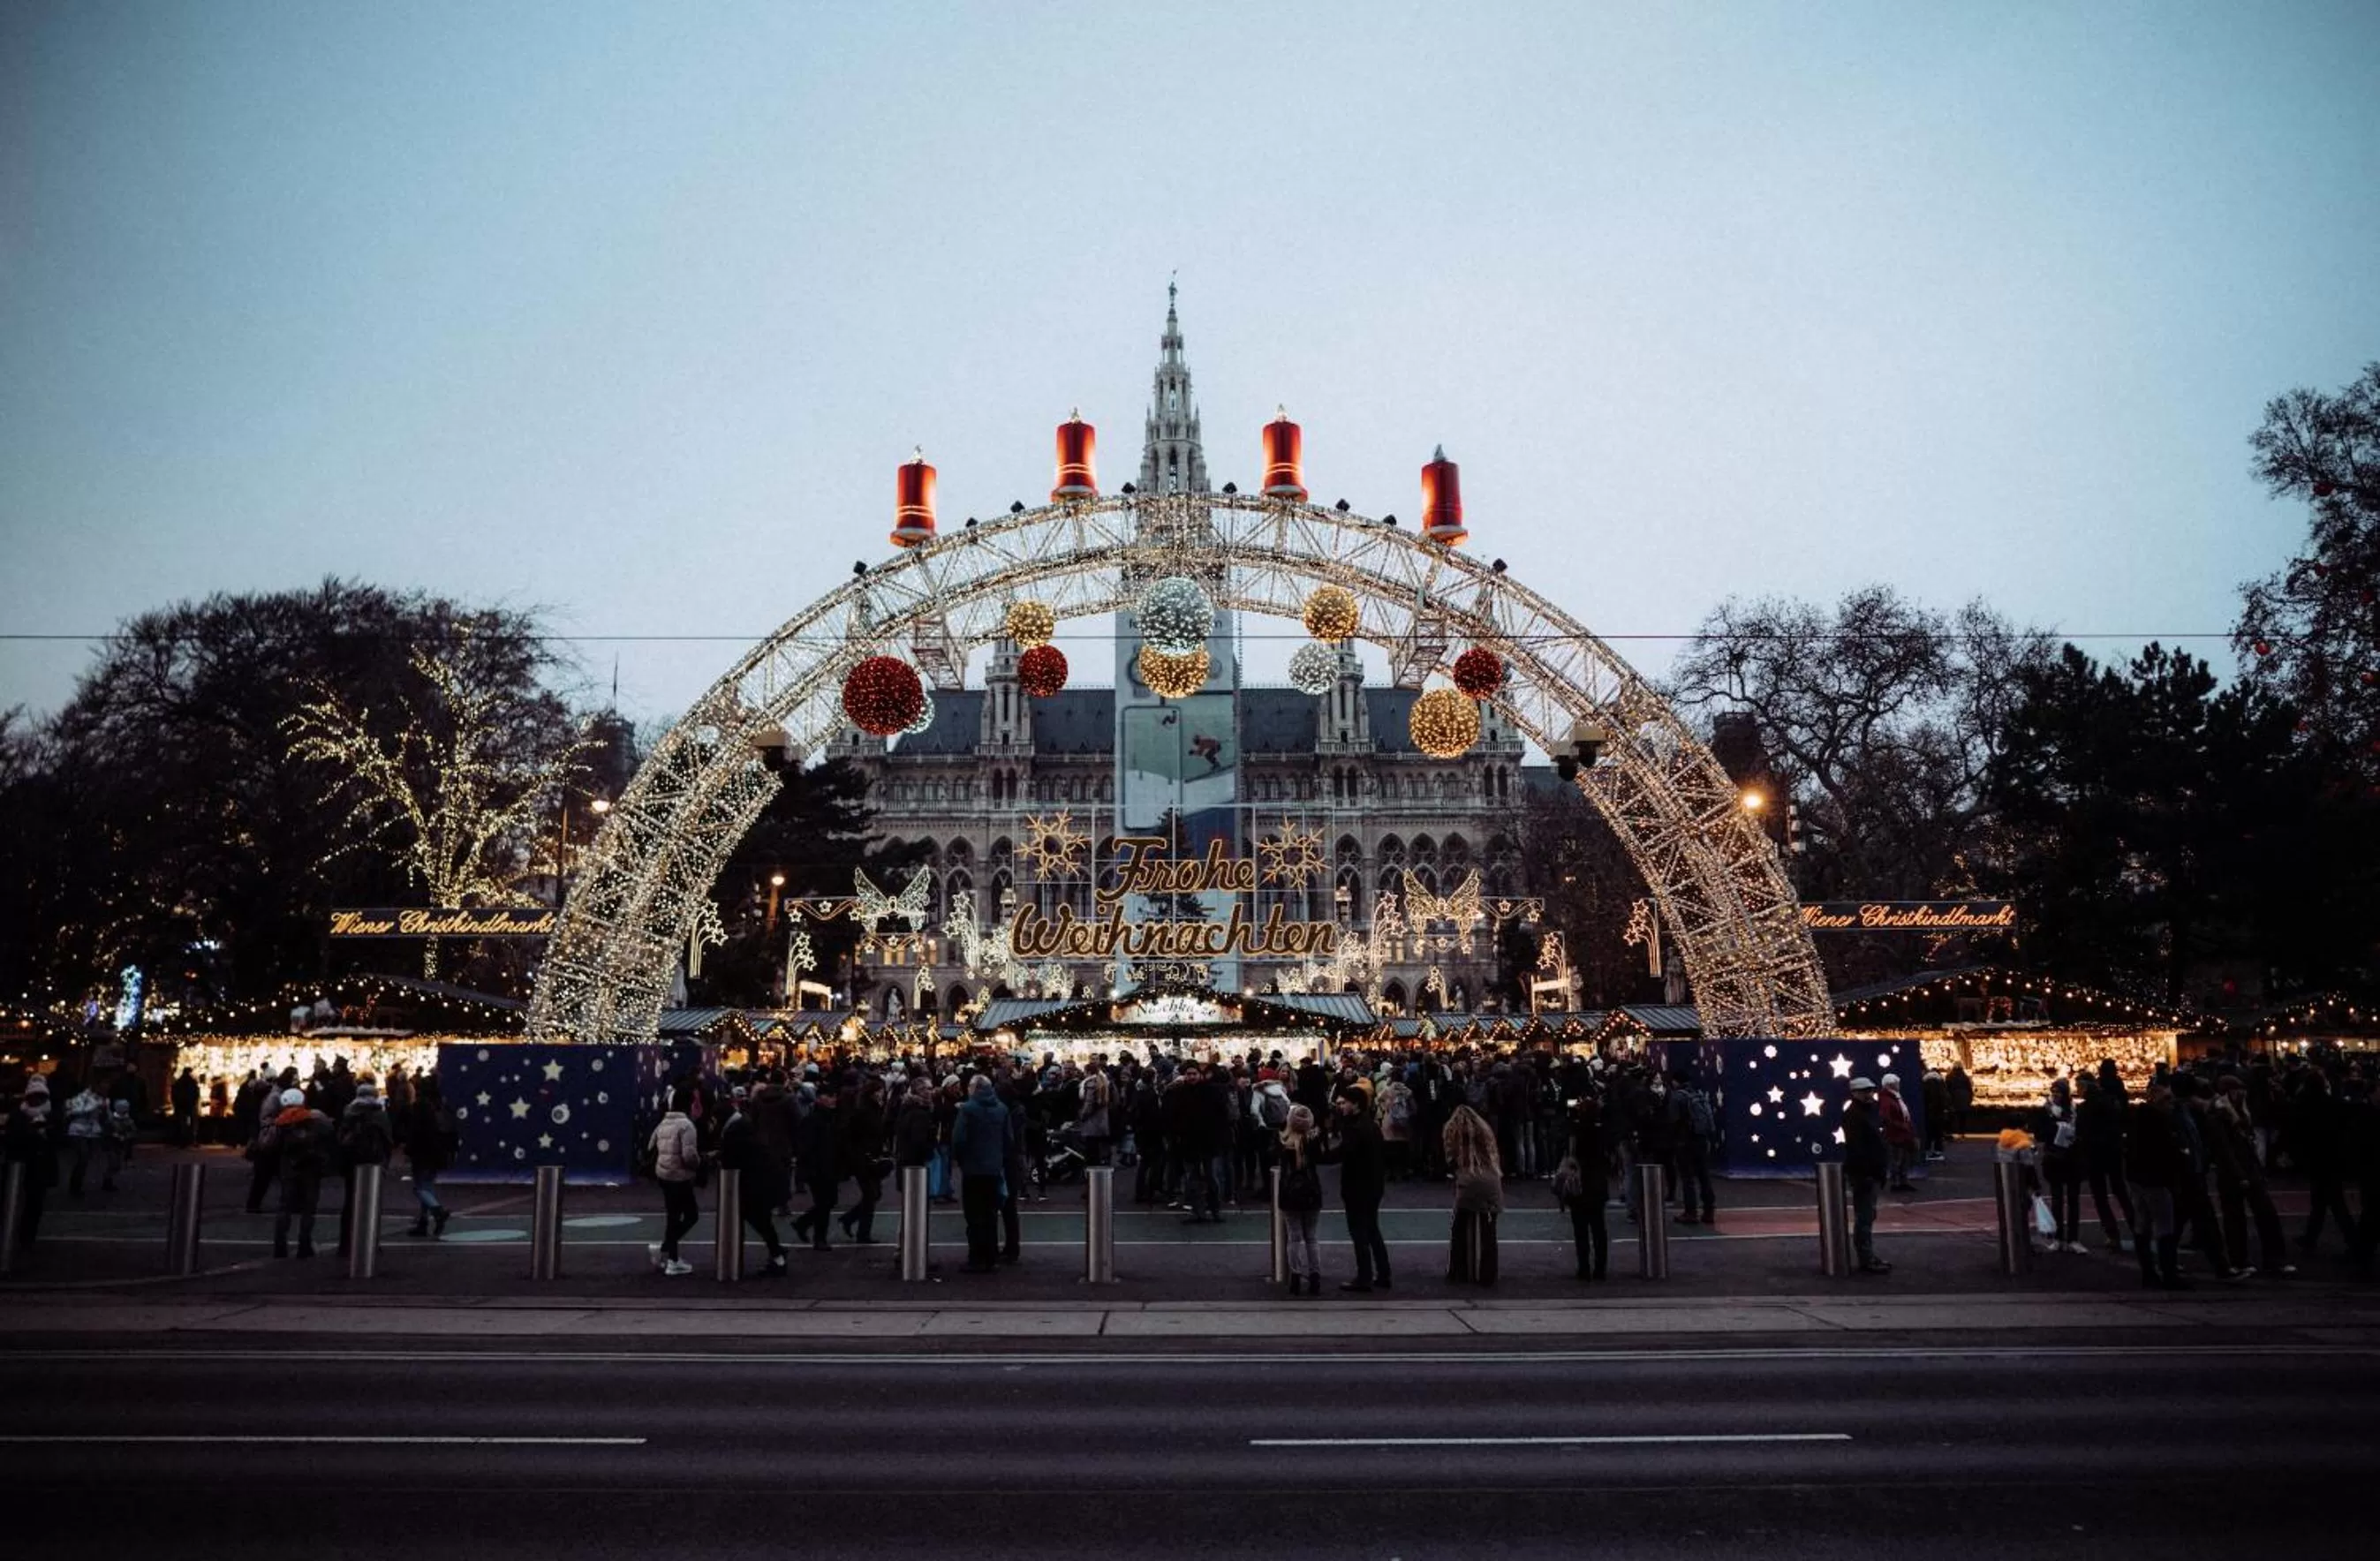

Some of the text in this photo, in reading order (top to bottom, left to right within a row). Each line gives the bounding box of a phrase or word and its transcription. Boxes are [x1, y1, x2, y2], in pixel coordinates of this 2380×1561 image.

[1095, 837, 1255, 902] Frohe
[330, 909, 557, 934] Wiener Christkindlmarkt
[1859, 903, 2016, 927] Christkindlmarkt
[1012, 902, 1337, 956] Weihnachten
[1137, 999, 1216, 1017] Naschkaze
